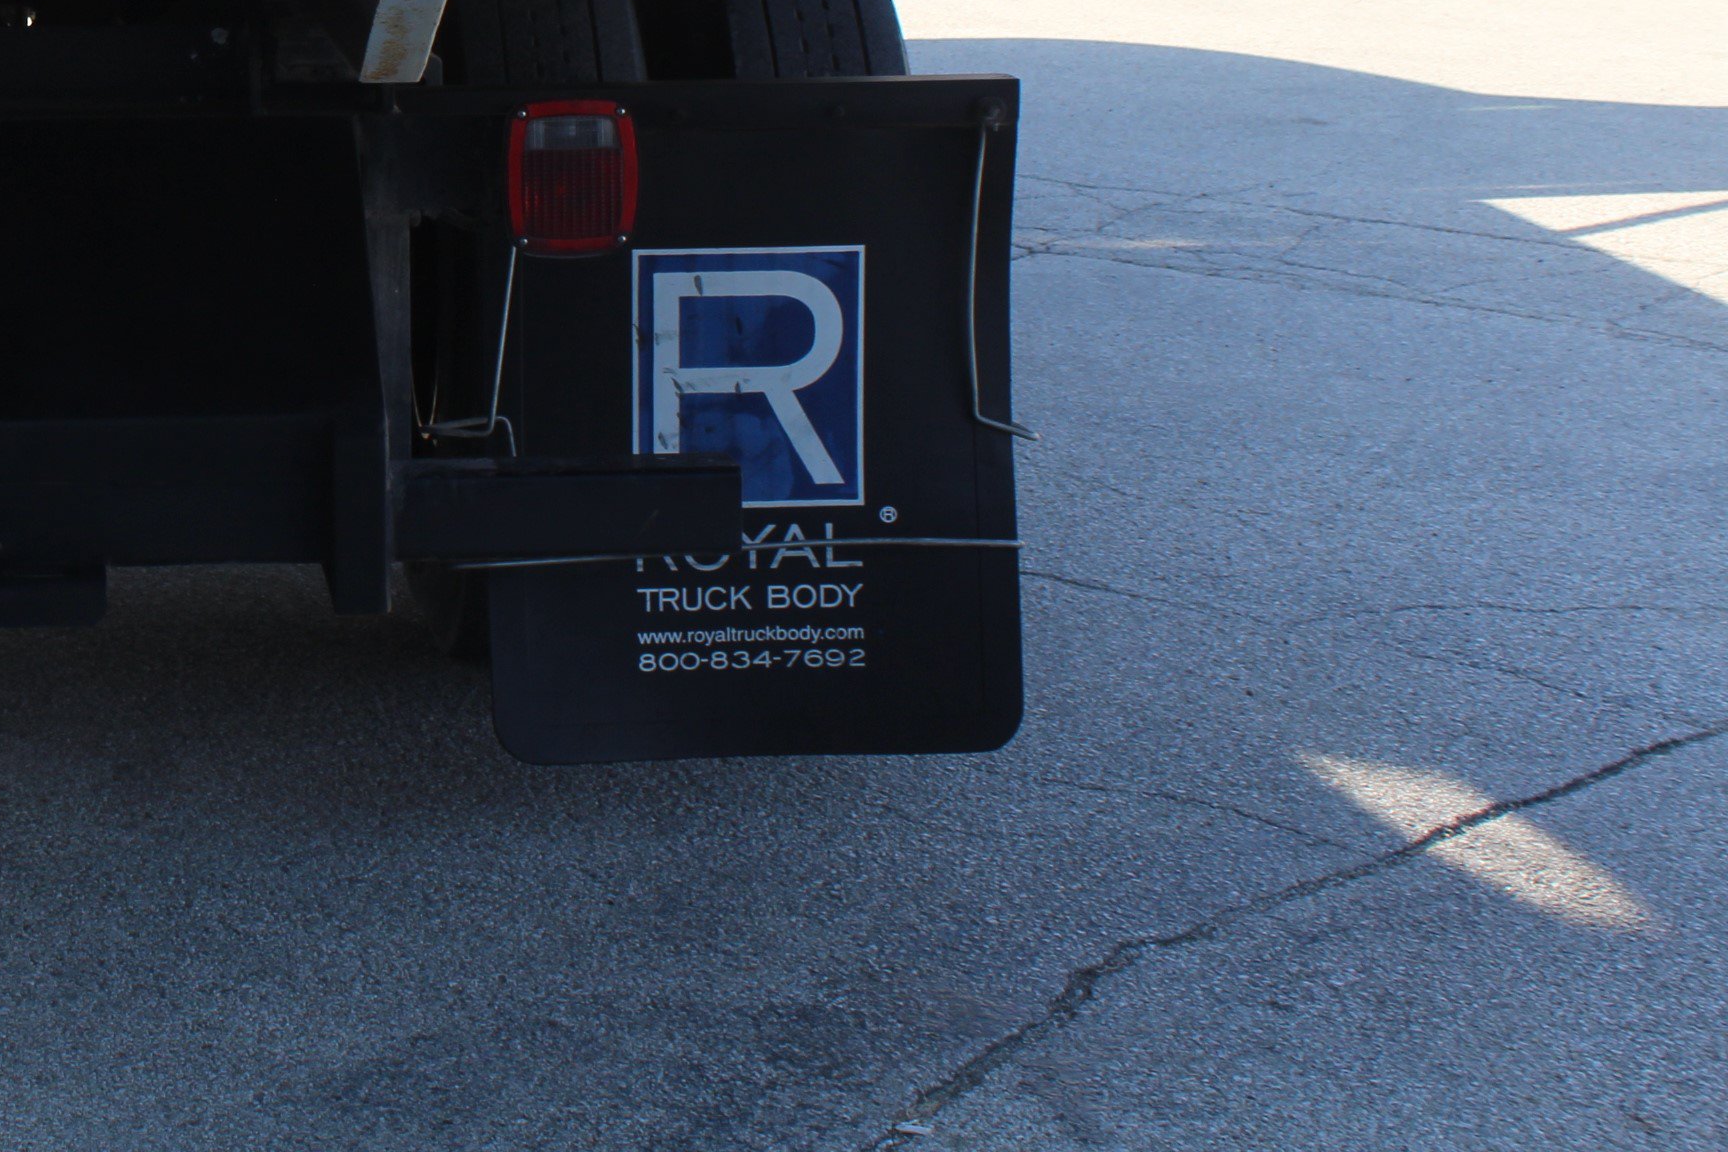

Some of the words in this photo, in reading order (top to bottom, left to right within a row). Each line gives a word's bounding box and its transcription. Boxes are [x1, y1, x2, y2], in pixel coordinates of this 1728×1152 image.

[636, 585, 753, 613] TRUCK
[766, 583, 864, 609] BODY
[637, 625, 865, 647] www.royaltruckbody.com
[638, 648, 866, 672] 800-834-7692
